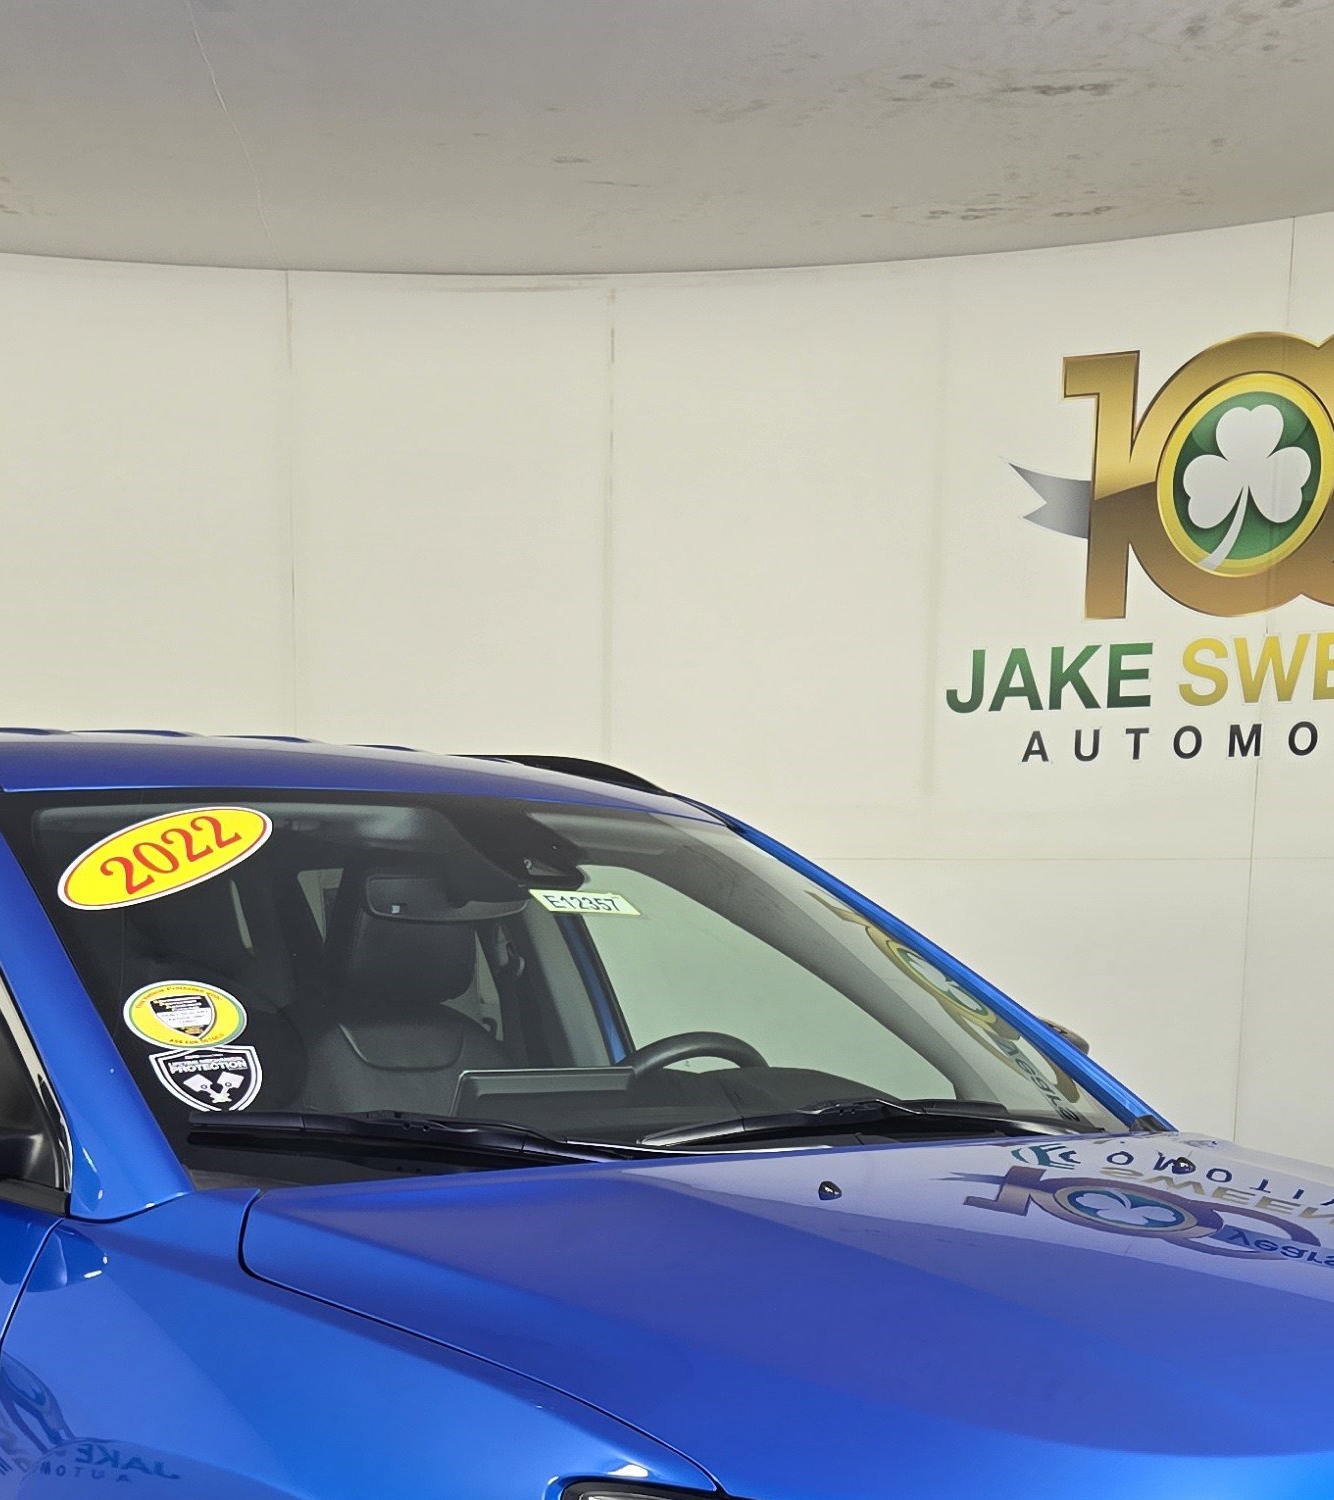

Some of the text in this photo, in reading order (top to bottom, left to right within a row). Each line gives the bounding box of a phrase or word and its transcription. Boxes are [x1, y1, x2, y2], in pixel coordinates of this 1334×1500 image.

[945, 641, 1154, 714] JAKE
[100, 815, 243, 895] 2022
[542, 894, 621, 912] E12357
